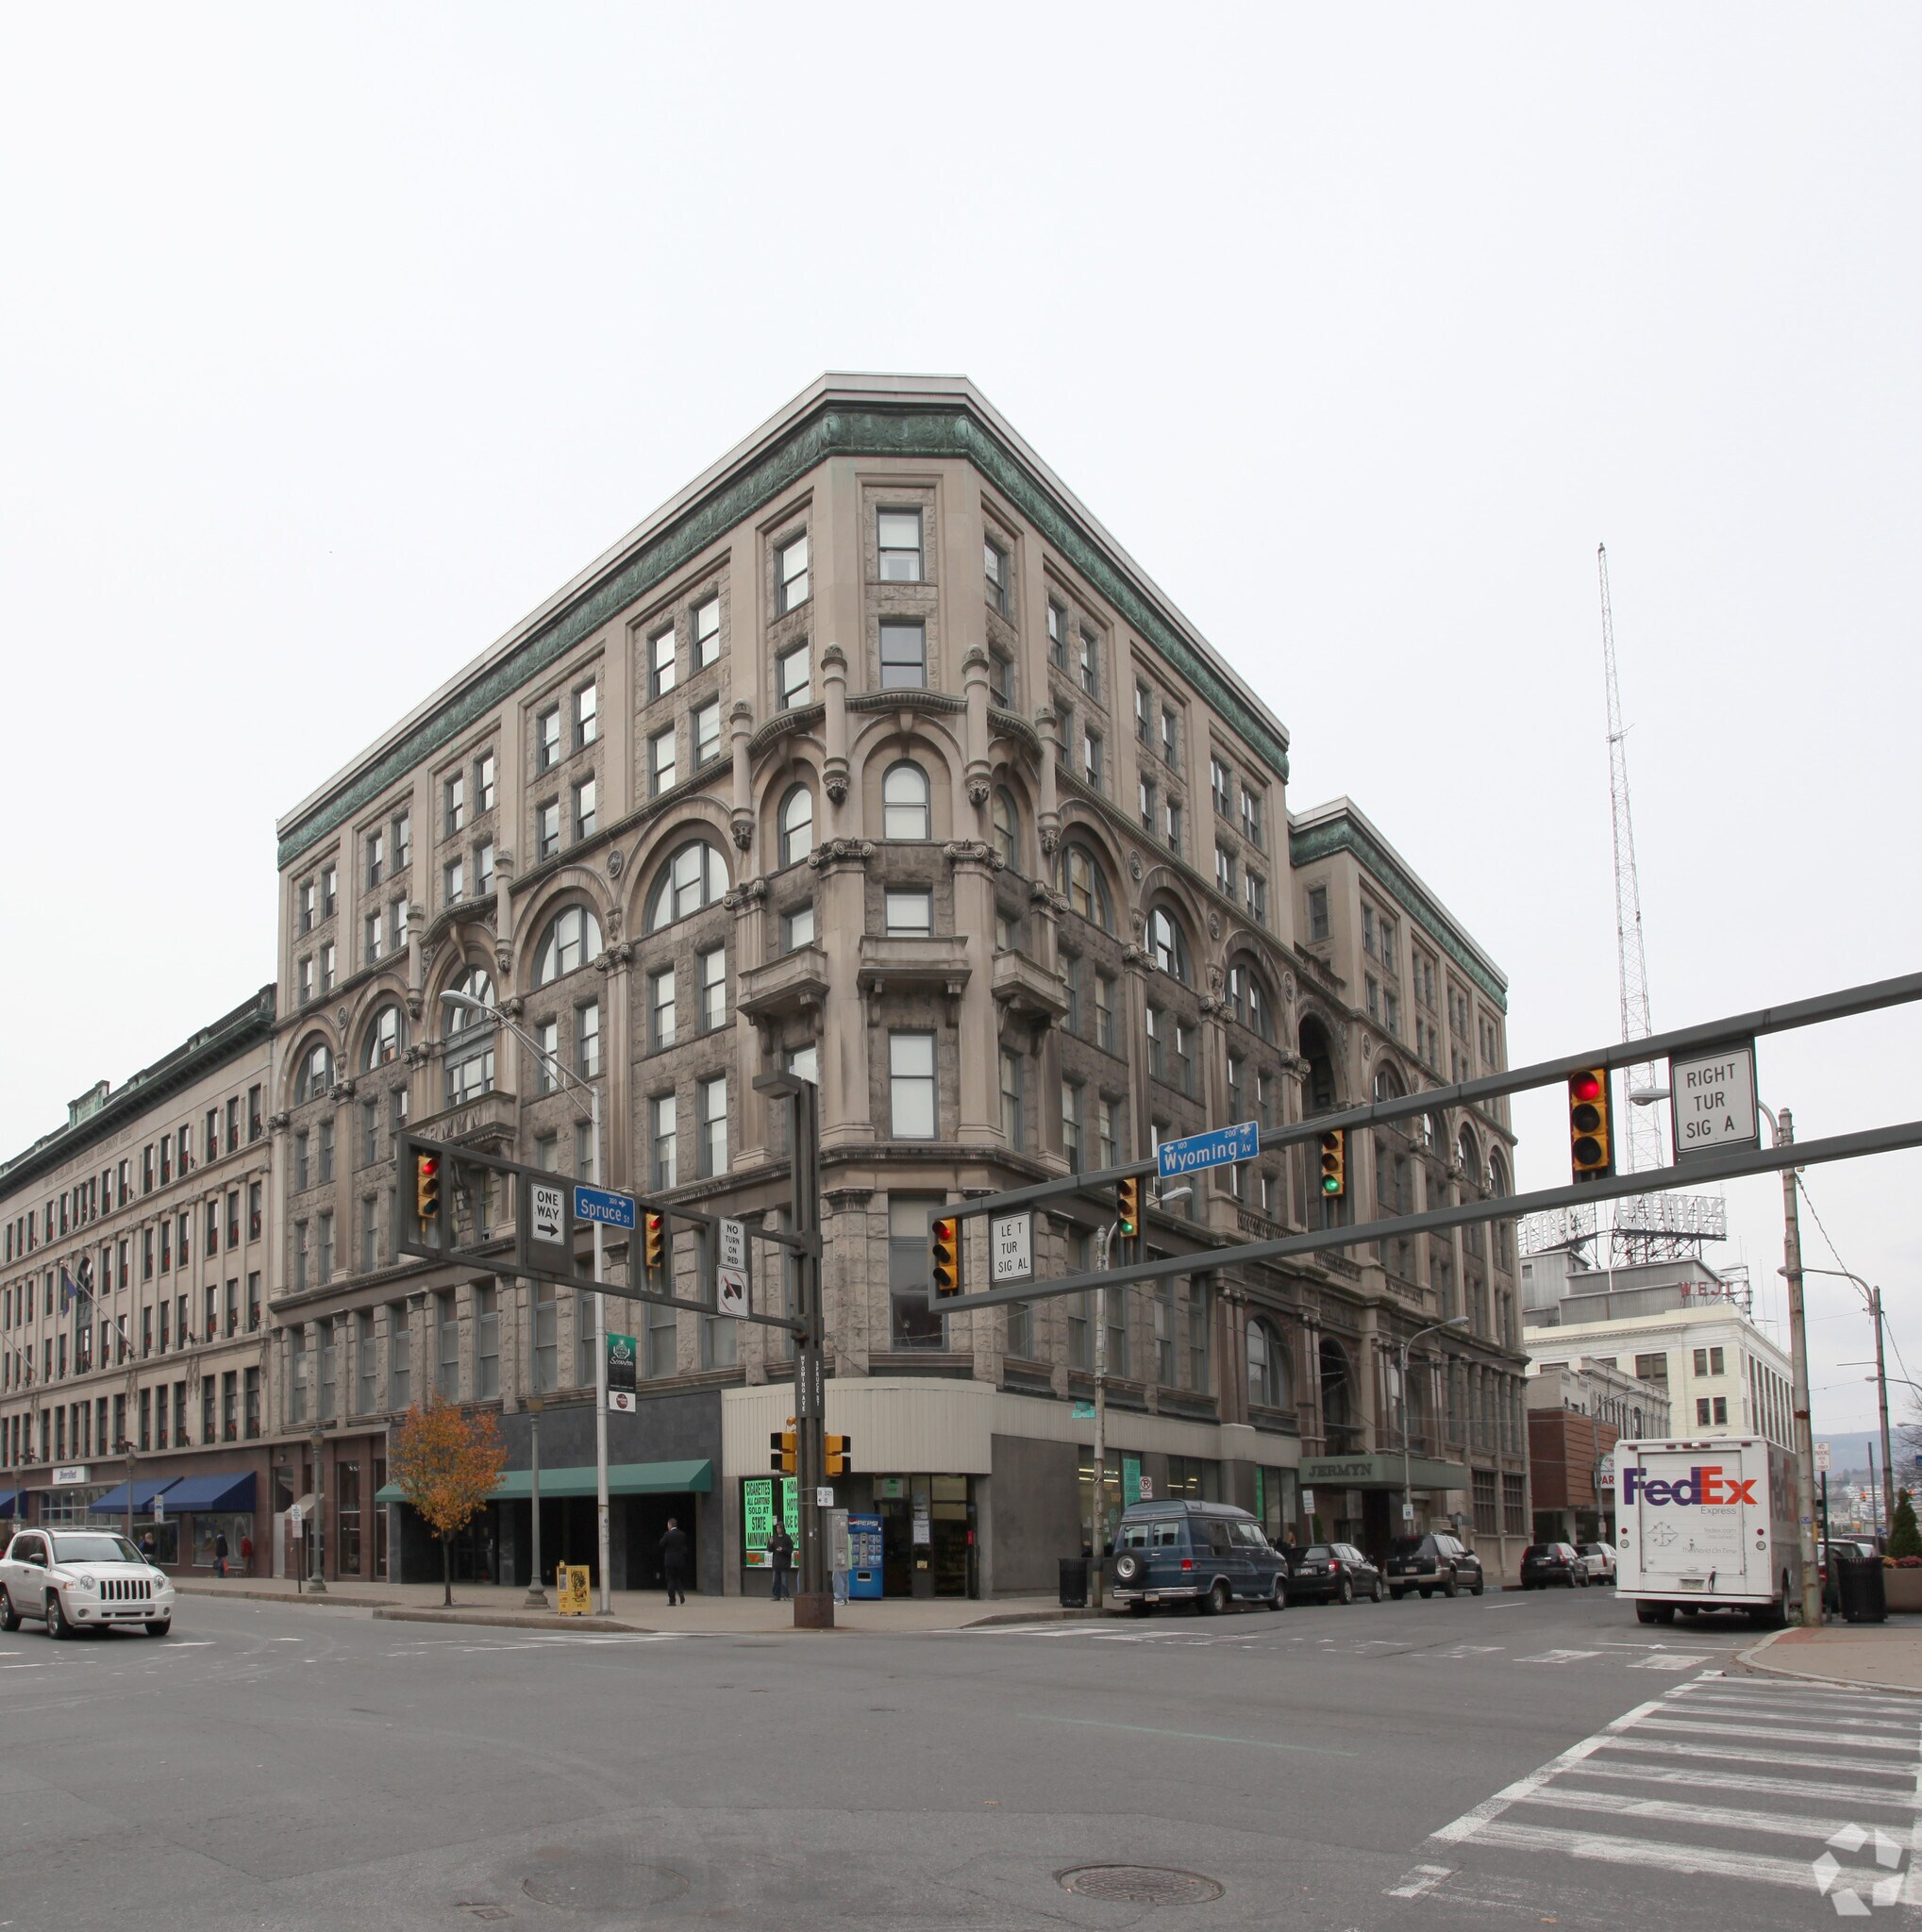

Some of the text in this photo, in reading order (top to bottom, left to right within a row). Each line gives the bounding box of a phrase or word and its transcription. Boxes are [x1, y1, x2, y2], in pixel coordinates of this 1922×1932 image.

[1687, 1063, 1735, 1089] RIGHT
[1694, 1091, 1725, 1111] TUR
[1224, 1128, 1237, 1139] 200
[1178, 1141, 1188, 1150] 100
[1164, 1141, 1251, 1172] Wyoming Av
[537, 1191, 559, 1207] ONE
[537, 1205, 560, 1220] WAY
[580, 1198, 630, 1224] Spruce St
[727, 1224, 739, 1234] NO
[726, 1235, 740, 1245] TURN
[1001, 1241, 1017, 1255] TUR
[727, 1256, 739, 1264] RED
[1309, 1463, 1373, 1477] JERMYN
[1601, 1475, 1614, 1485] AR
[1623, 1466, 1759, 1507] FedEx
[746, 1481, 771, 1496] CIGARETTES
[1700, 1506, 1736, 1516] Express
[751, 1516, 766, 1531] STATE
